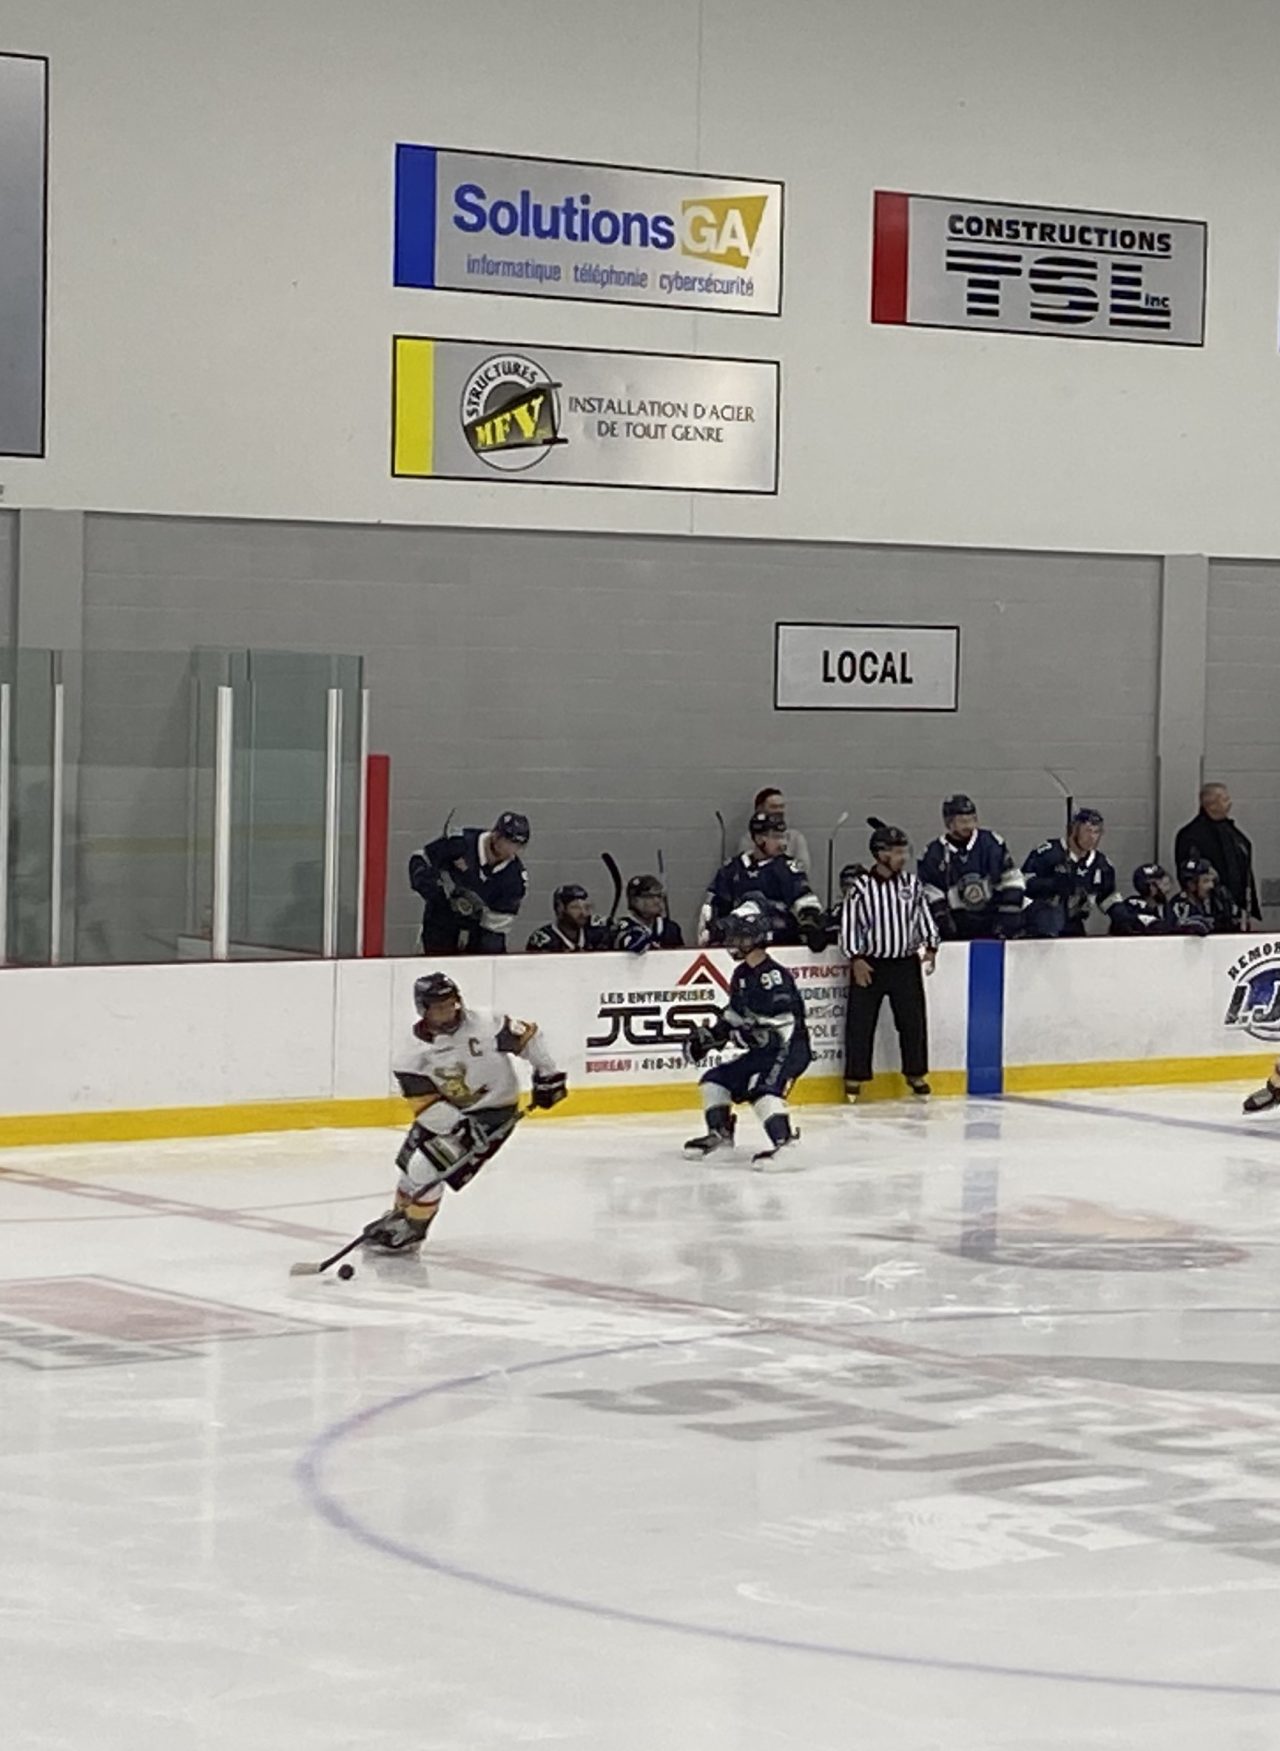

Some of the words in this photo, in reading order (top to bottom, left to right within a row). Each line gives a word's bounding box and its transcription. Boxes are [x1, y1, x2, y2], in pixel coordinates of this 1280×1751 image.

[453, 183, 675, 250] Solutions
[682, 205, 750, 257] GA
[947, 214, 1171, 252] CONSTRUCTIONS
[466, 254, 561, 284] informatique
[573, 263, 648, 289] téléphonie
[659, 273, 754, 297] cybersécurité
[946, 249, 1171, 329] TSL
[466, 360, 538, 418] STRUCTURES
[569, 396, 687, 419] INSTALLATION
[475, 395, 544, 446] MFV
[598, 420, 618, 438] DE
[625, 421, 667, 440] TOUT
[672, 423, 724, 443] GENRE
[822, 650, 913, 684] LOCAL
[788, 965, 850, 979] STRUCT
[600, 992, 625, 1004] LES
[628, 989, 716, 1004] ENTREPRISES
